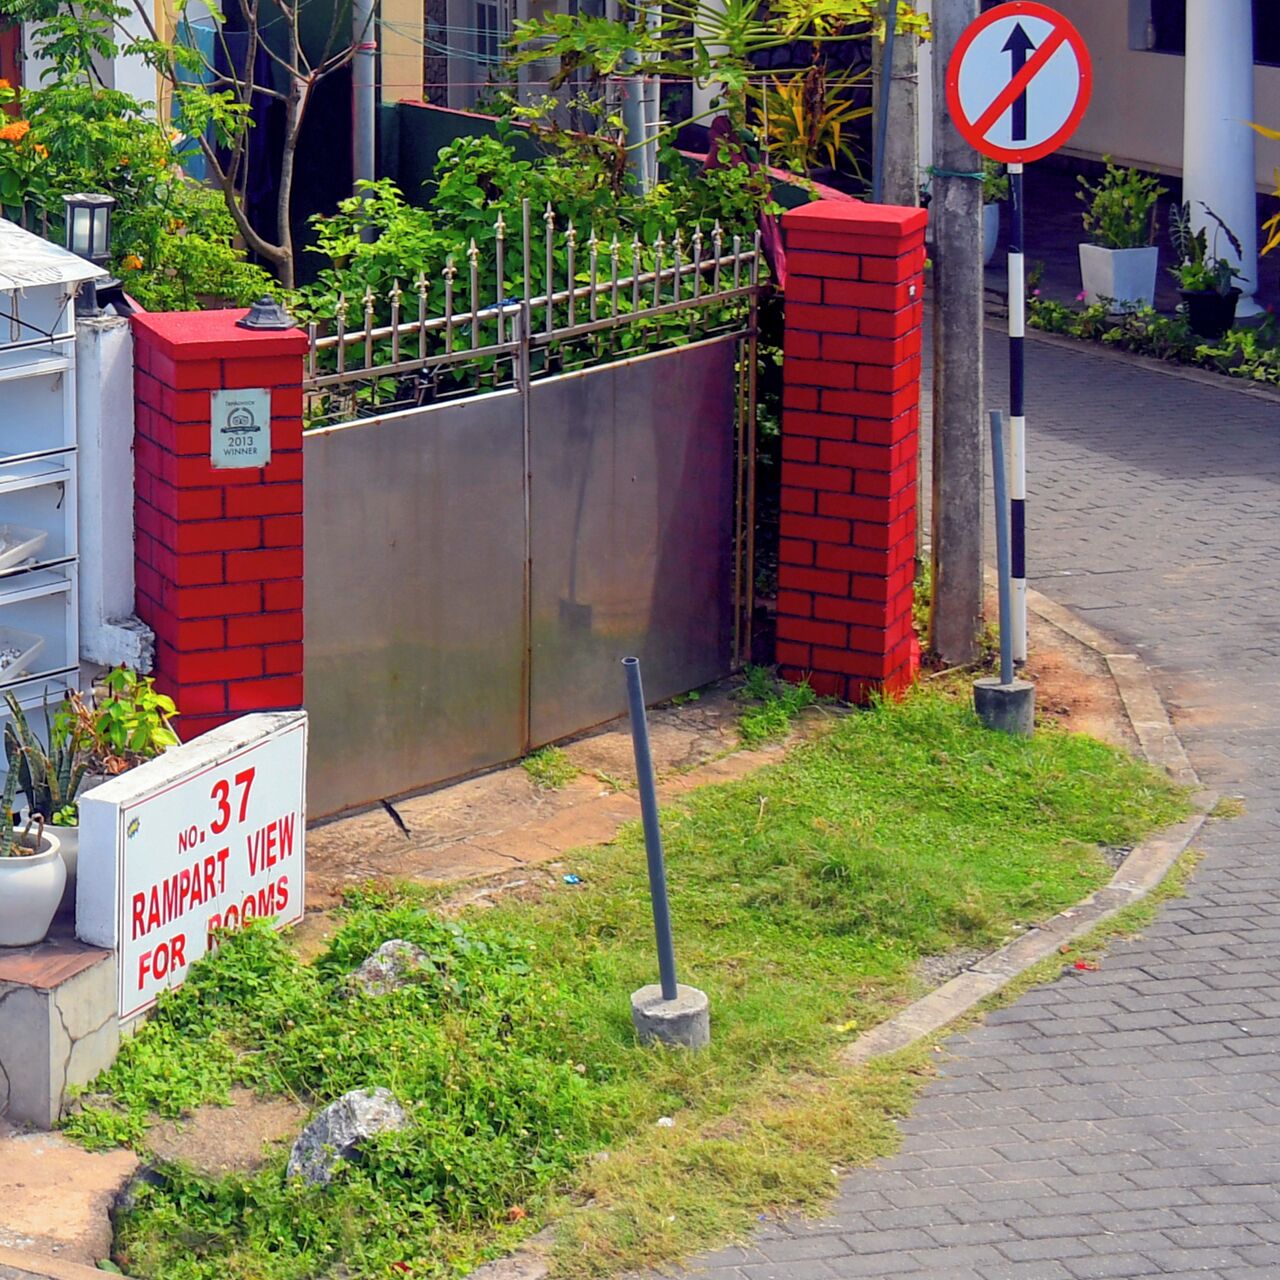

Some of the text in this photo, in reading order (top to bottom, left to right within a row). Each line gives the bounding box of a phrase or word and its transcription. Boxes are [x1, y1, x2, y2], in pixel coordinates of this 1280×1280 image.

[223, 447, 258, 456] WINNER
[227, 436, 254, 447] 2013
[210, 767, 255, 834] 37
[131, 812, 295, 941] RAMPART VIEW
[138, 933, 186, 990] FOR
